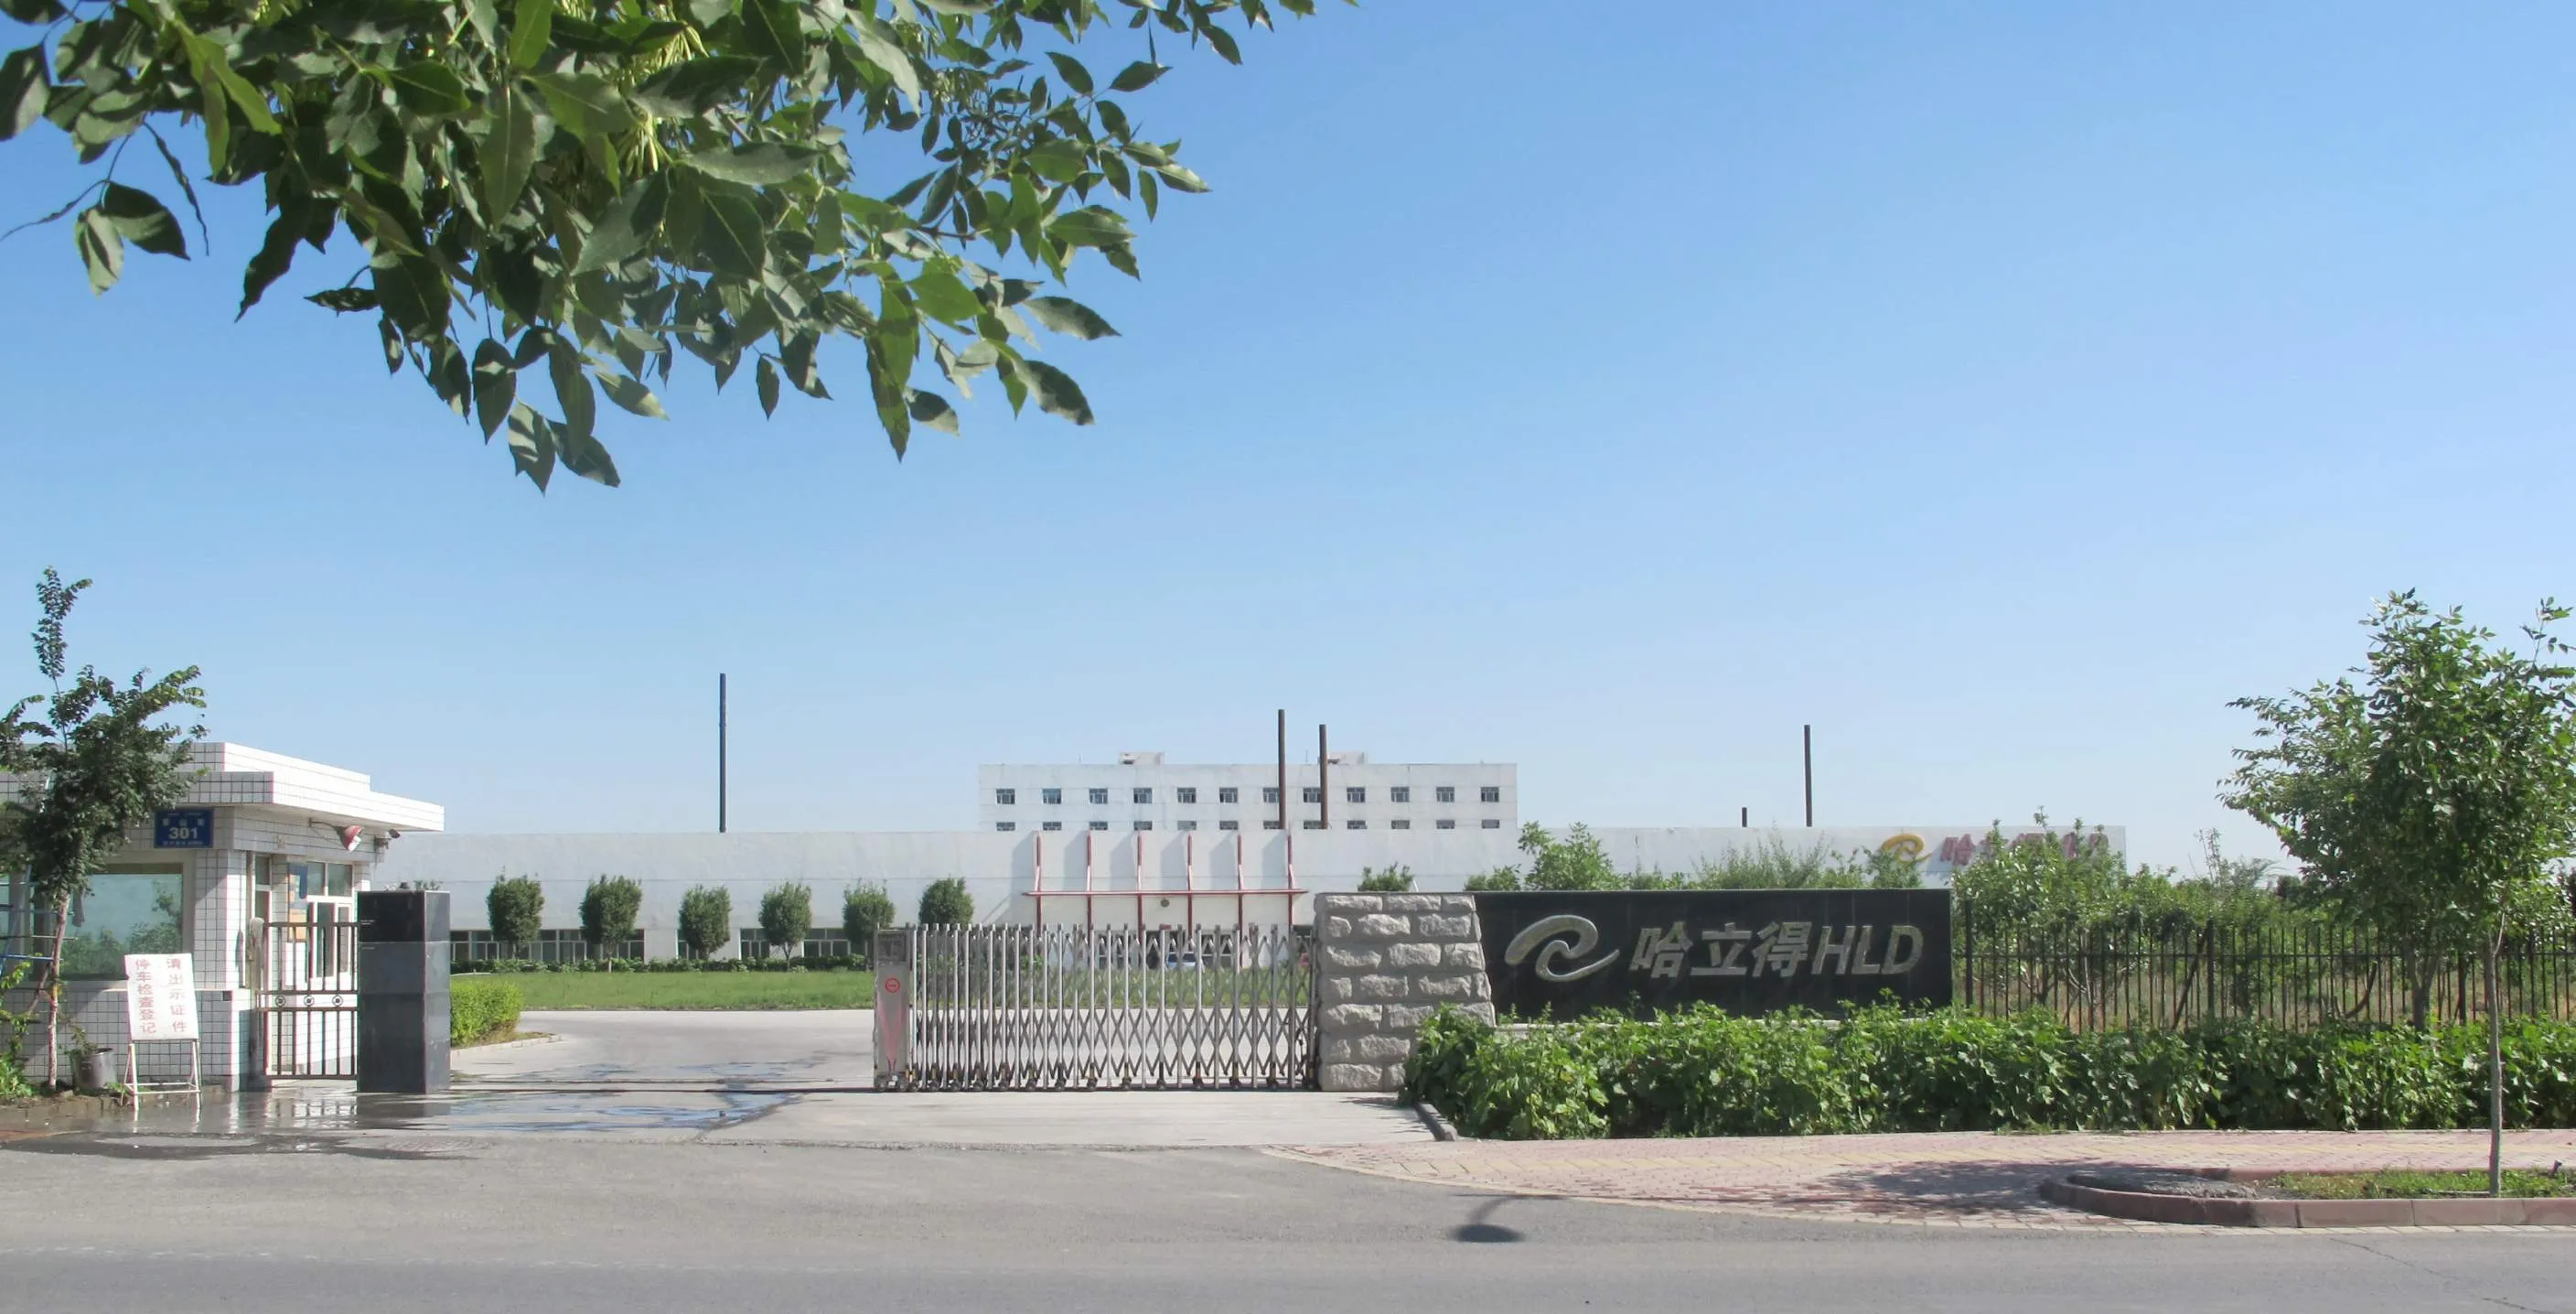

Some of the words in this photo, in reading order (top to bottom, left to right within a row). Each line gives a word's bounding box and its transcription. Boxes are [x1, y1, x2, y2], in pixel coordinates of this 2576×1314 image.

[168, 827, 198, 839] 301
[135, 958, 156, 1033] 停车检查登记
[166, 958, 187, 1032] 请出示证件
